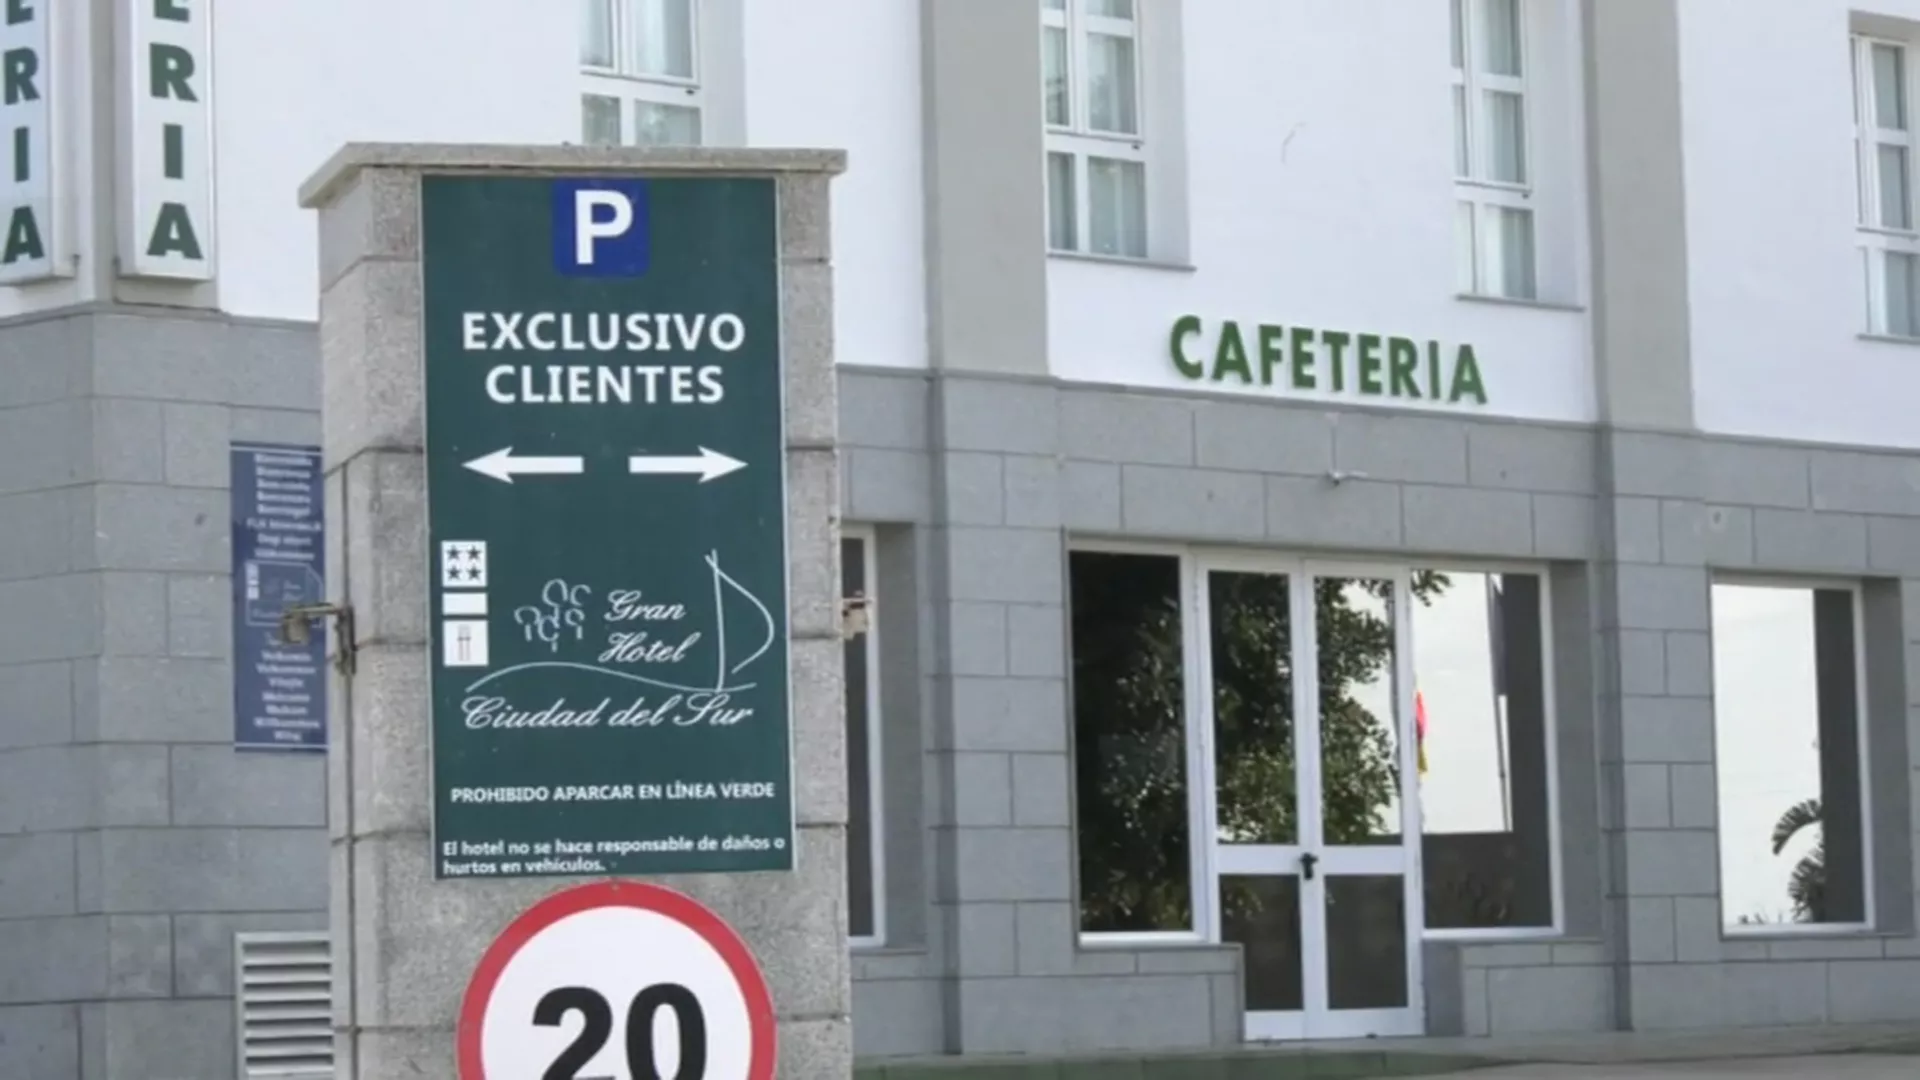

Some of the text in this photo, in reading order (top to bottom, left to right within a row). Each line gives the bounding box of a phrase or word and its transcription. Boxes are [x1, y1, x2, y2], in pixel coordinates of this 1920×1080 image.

[576, 190, 632, 264] P
[463, 312, 744, 351] EXCLUSIVO
[1170, 315, 1487, 404] CAFETERIA
[486, 365, 723, 403] CLIENTES
[604, 590, 685, 621] Gran
[598, 632, 701, 662] Hotel
[460, 692, 754, 730] Ciudad del Sur
[451, 780, 775, 803] PROHIBIDO APARCAR EN LÍNEA VERDE
[443, 834, 785, 856] El hotel no se hace responsable de daños o
[443, 853, 606, 875] hurtos en vehículos.
[530, 980, 709, 1080] 20
